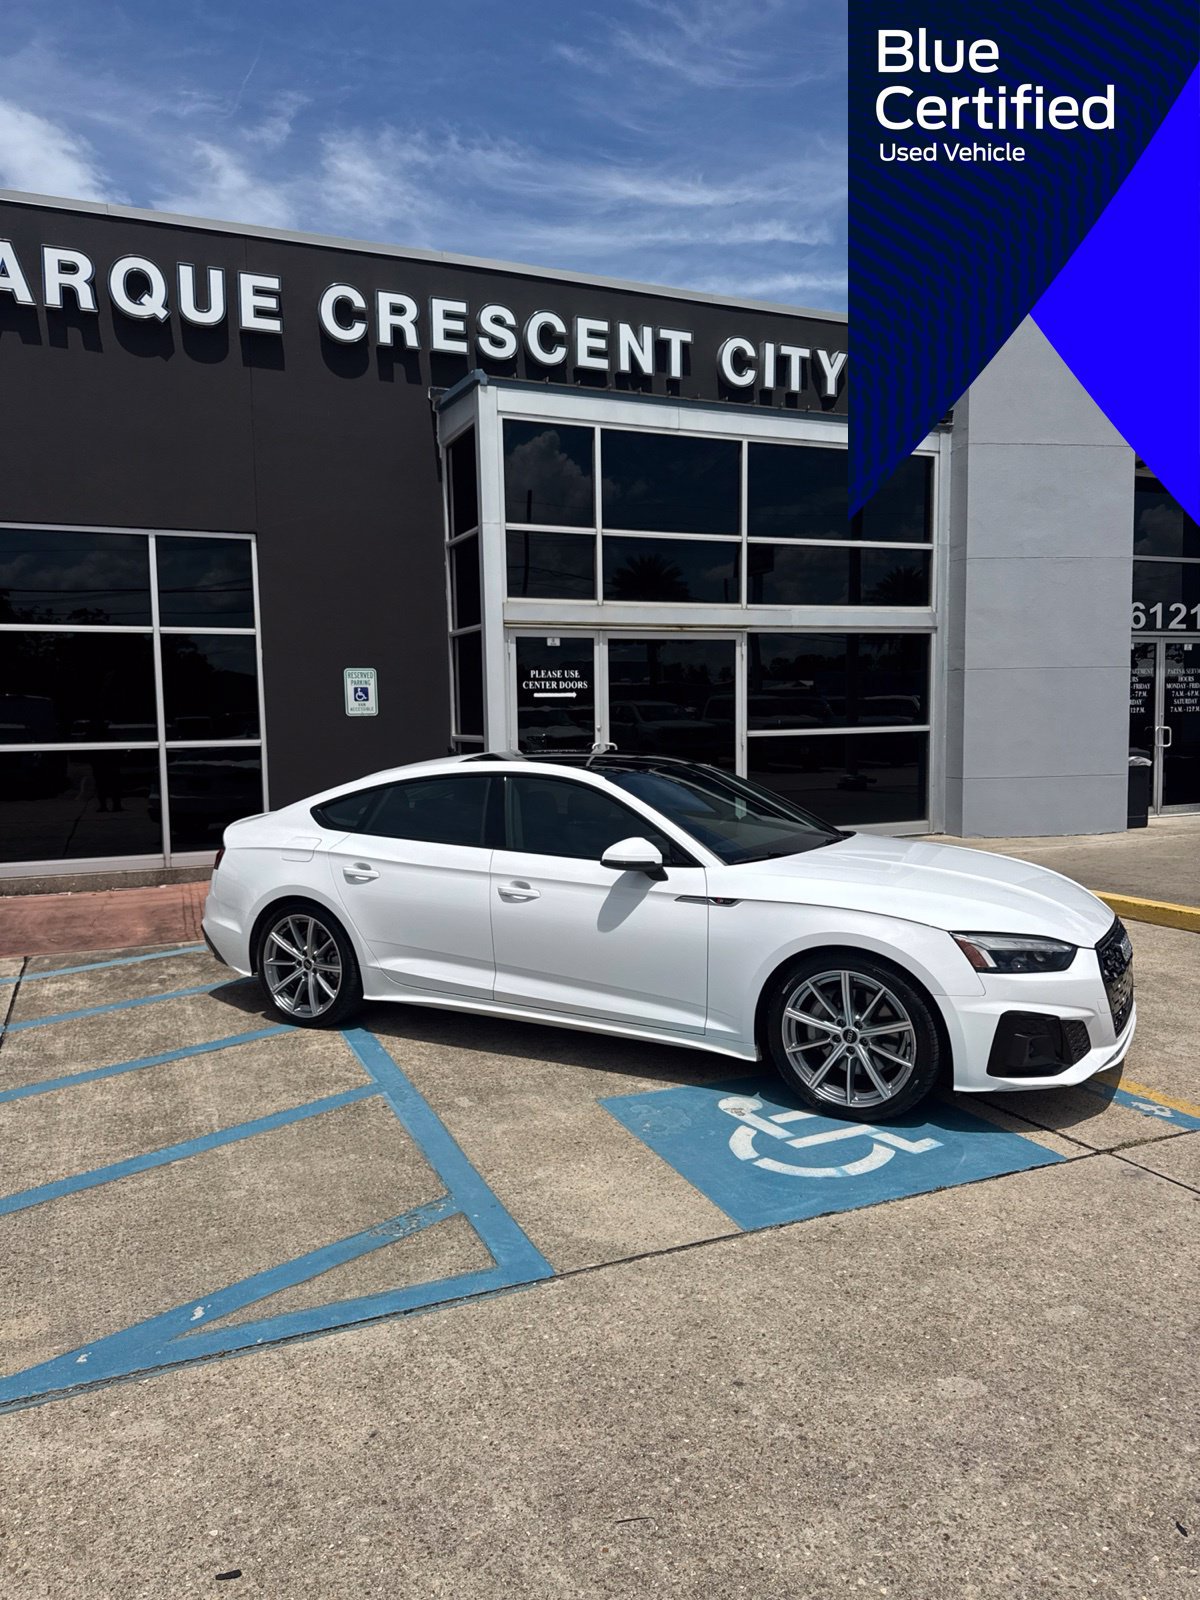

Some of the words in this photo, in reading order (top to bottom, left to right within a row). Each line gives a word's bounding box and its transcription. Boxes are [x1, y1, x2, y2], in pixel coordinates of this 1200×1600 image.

[0, 238, 284, 334] ARQUE
[318, 281, 694, 379] CRESCENT
[716, 334, 848, 397] CITY
[1131, 601, 1200, 629] 6121
[347, 671, 374, 679] RESERVED
[530, 669, 563, 679] PLEASE
[564, 669, 581, 679] USE
[522, 680, 558, 690] CENTER
[559, 680, 588, 690] DOORS
